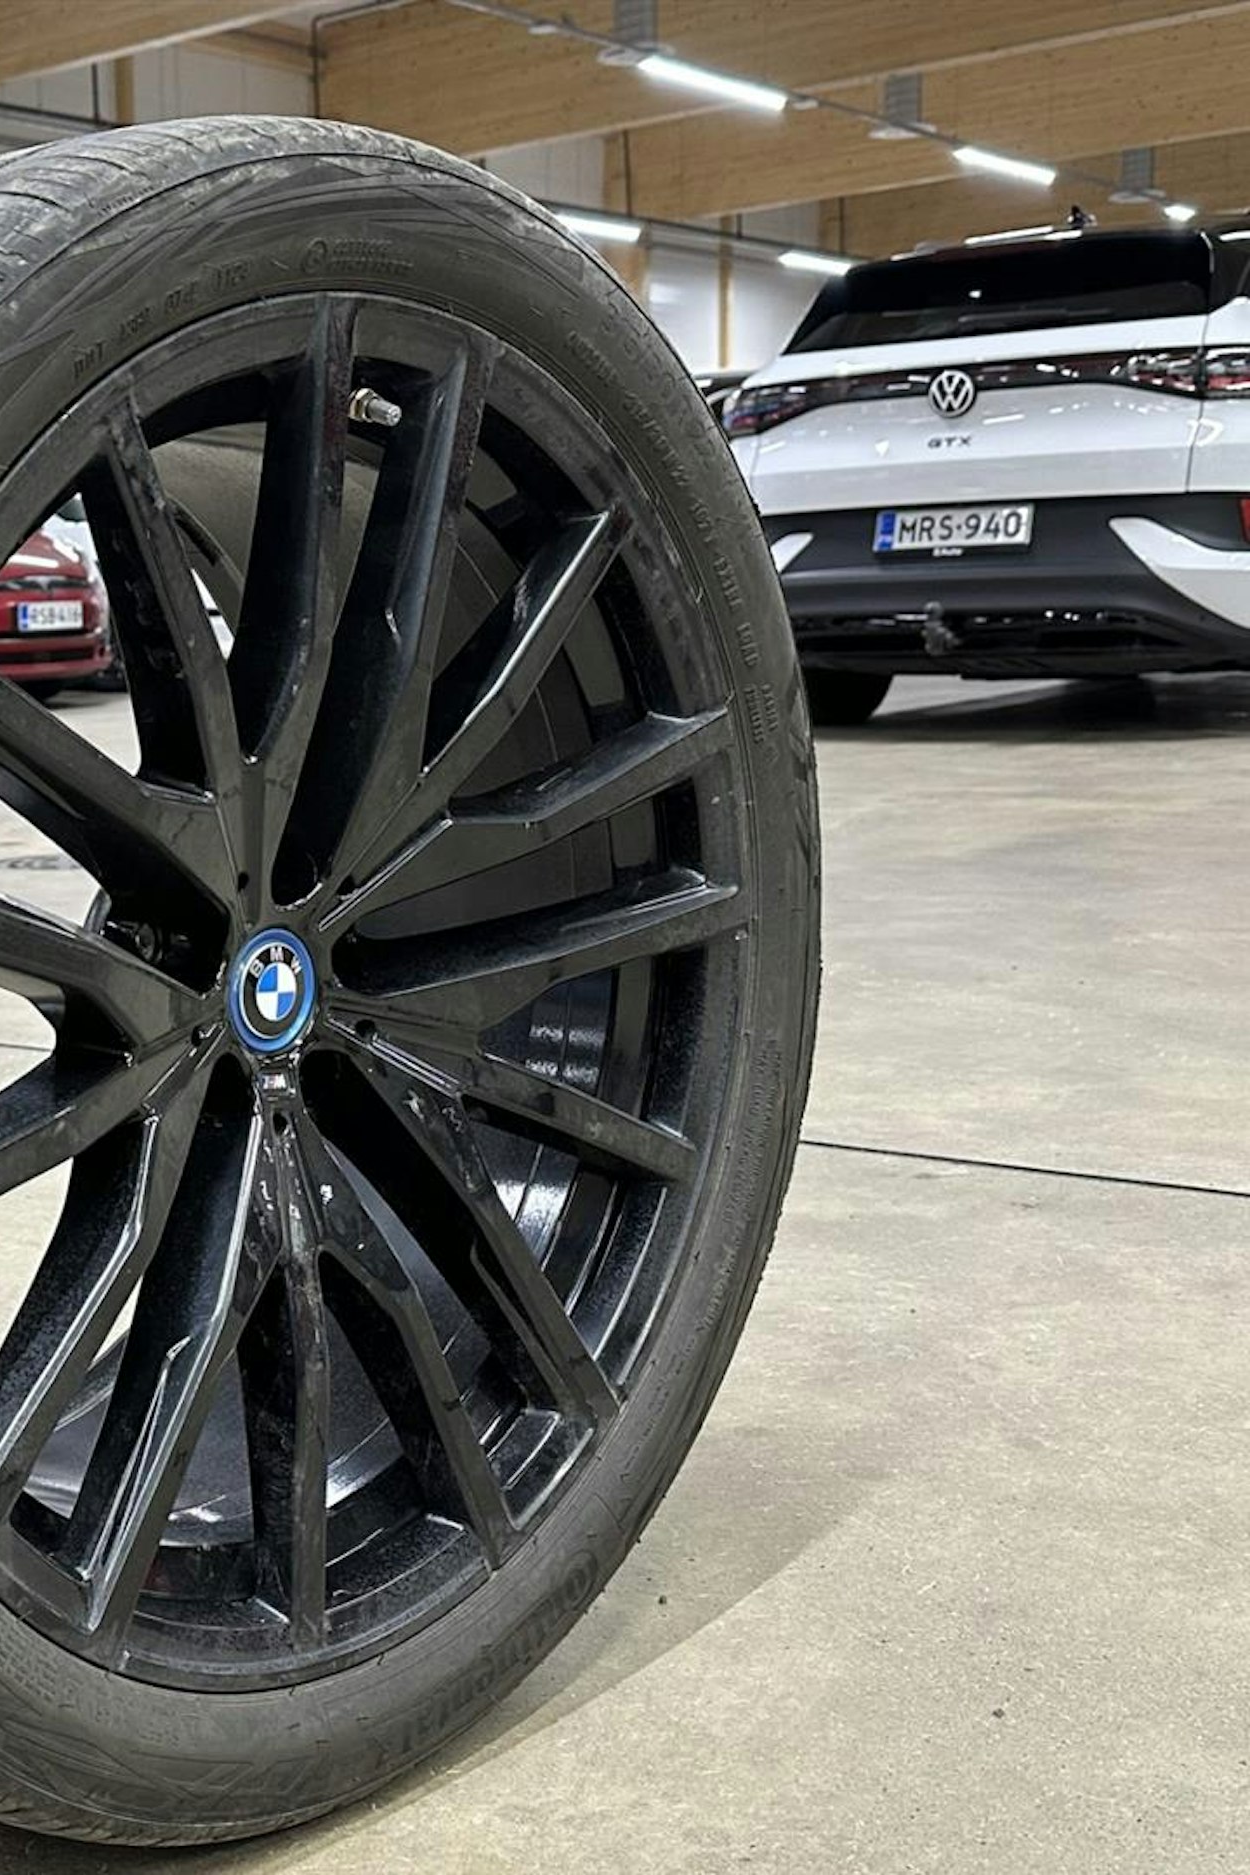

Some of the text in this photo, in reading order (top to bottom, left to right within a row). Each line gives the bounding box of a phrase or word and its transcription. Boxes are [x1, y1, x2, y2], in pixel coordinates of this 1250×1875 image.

[927, 435, 972, 450] GTX
[898, 511, 1023, 543] MRS-940
[249, 946, 302, 979] BMW
